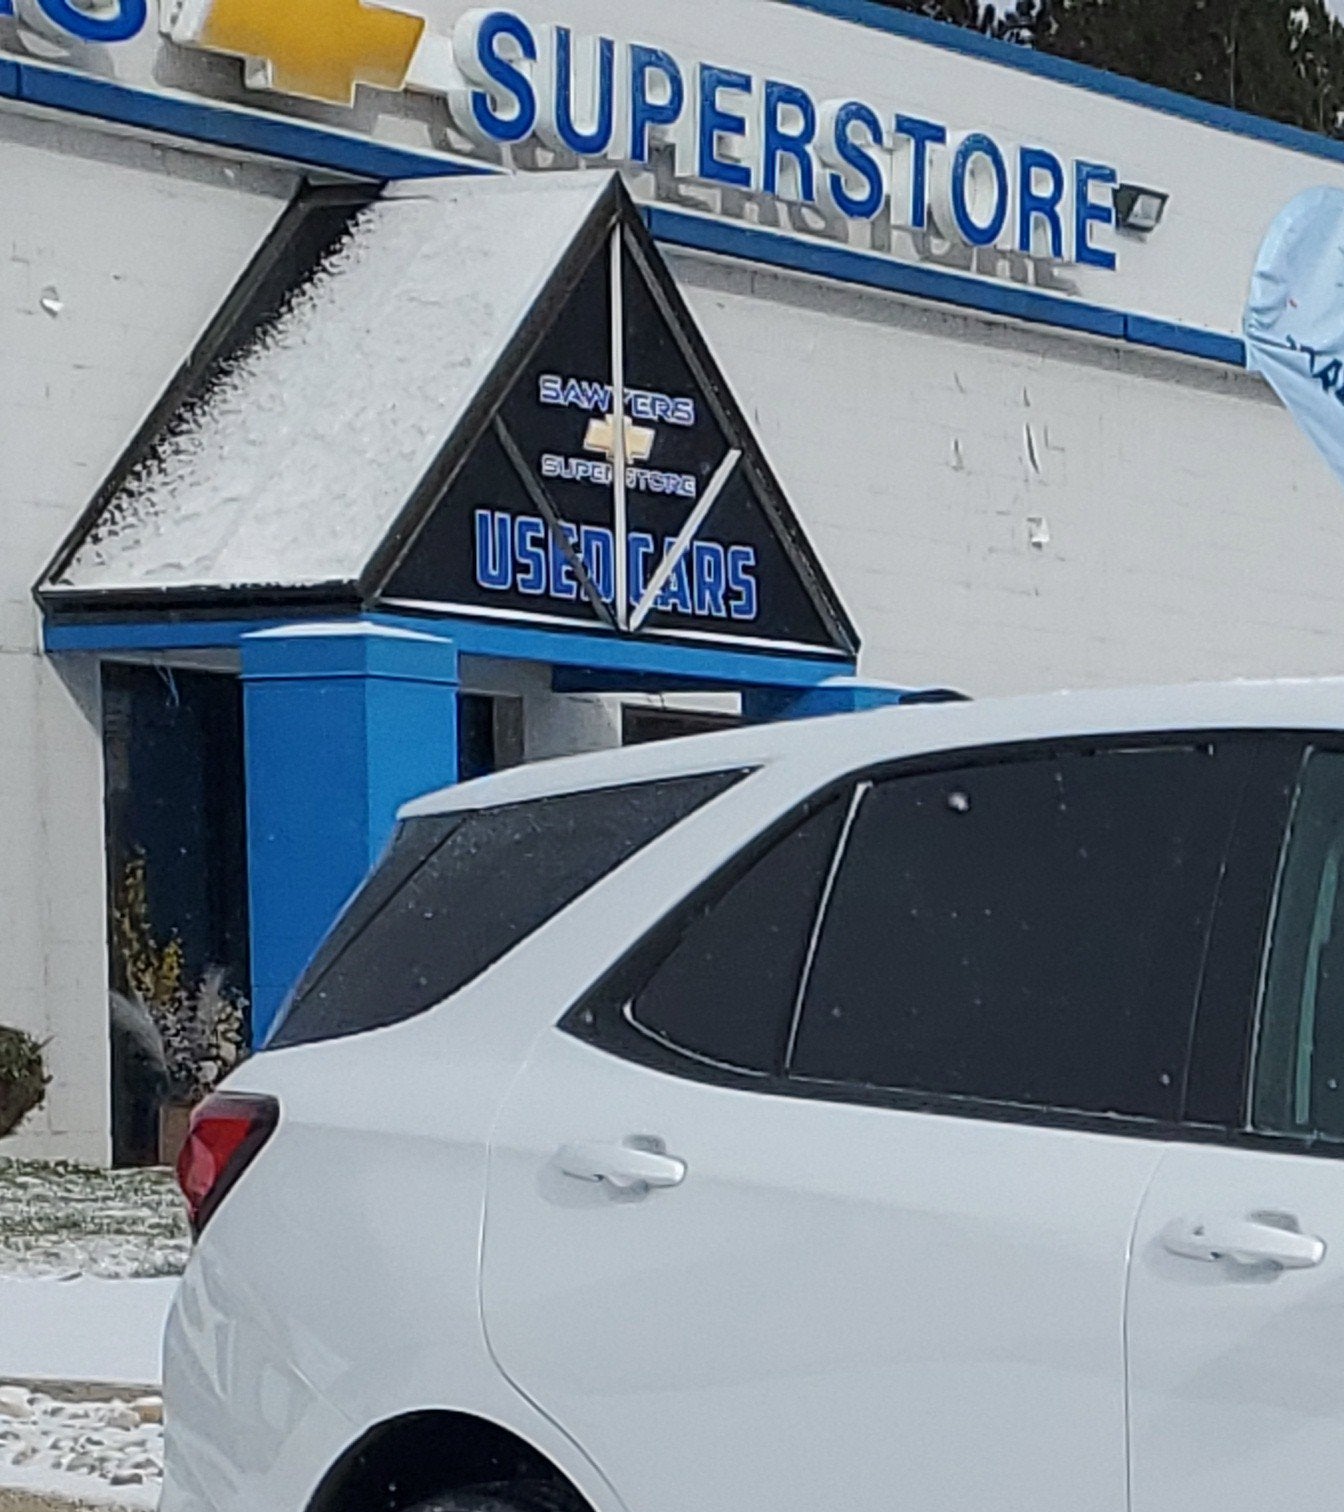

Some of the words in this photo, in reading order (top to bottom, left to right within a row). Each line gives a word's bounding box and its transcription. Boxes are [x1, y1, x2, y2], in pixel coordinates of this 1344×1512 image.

[469, 10, 1118, 271] SUPERSTORE
[474, 509, 615, 604] USED
[627, 531, 758, 620] CARS
